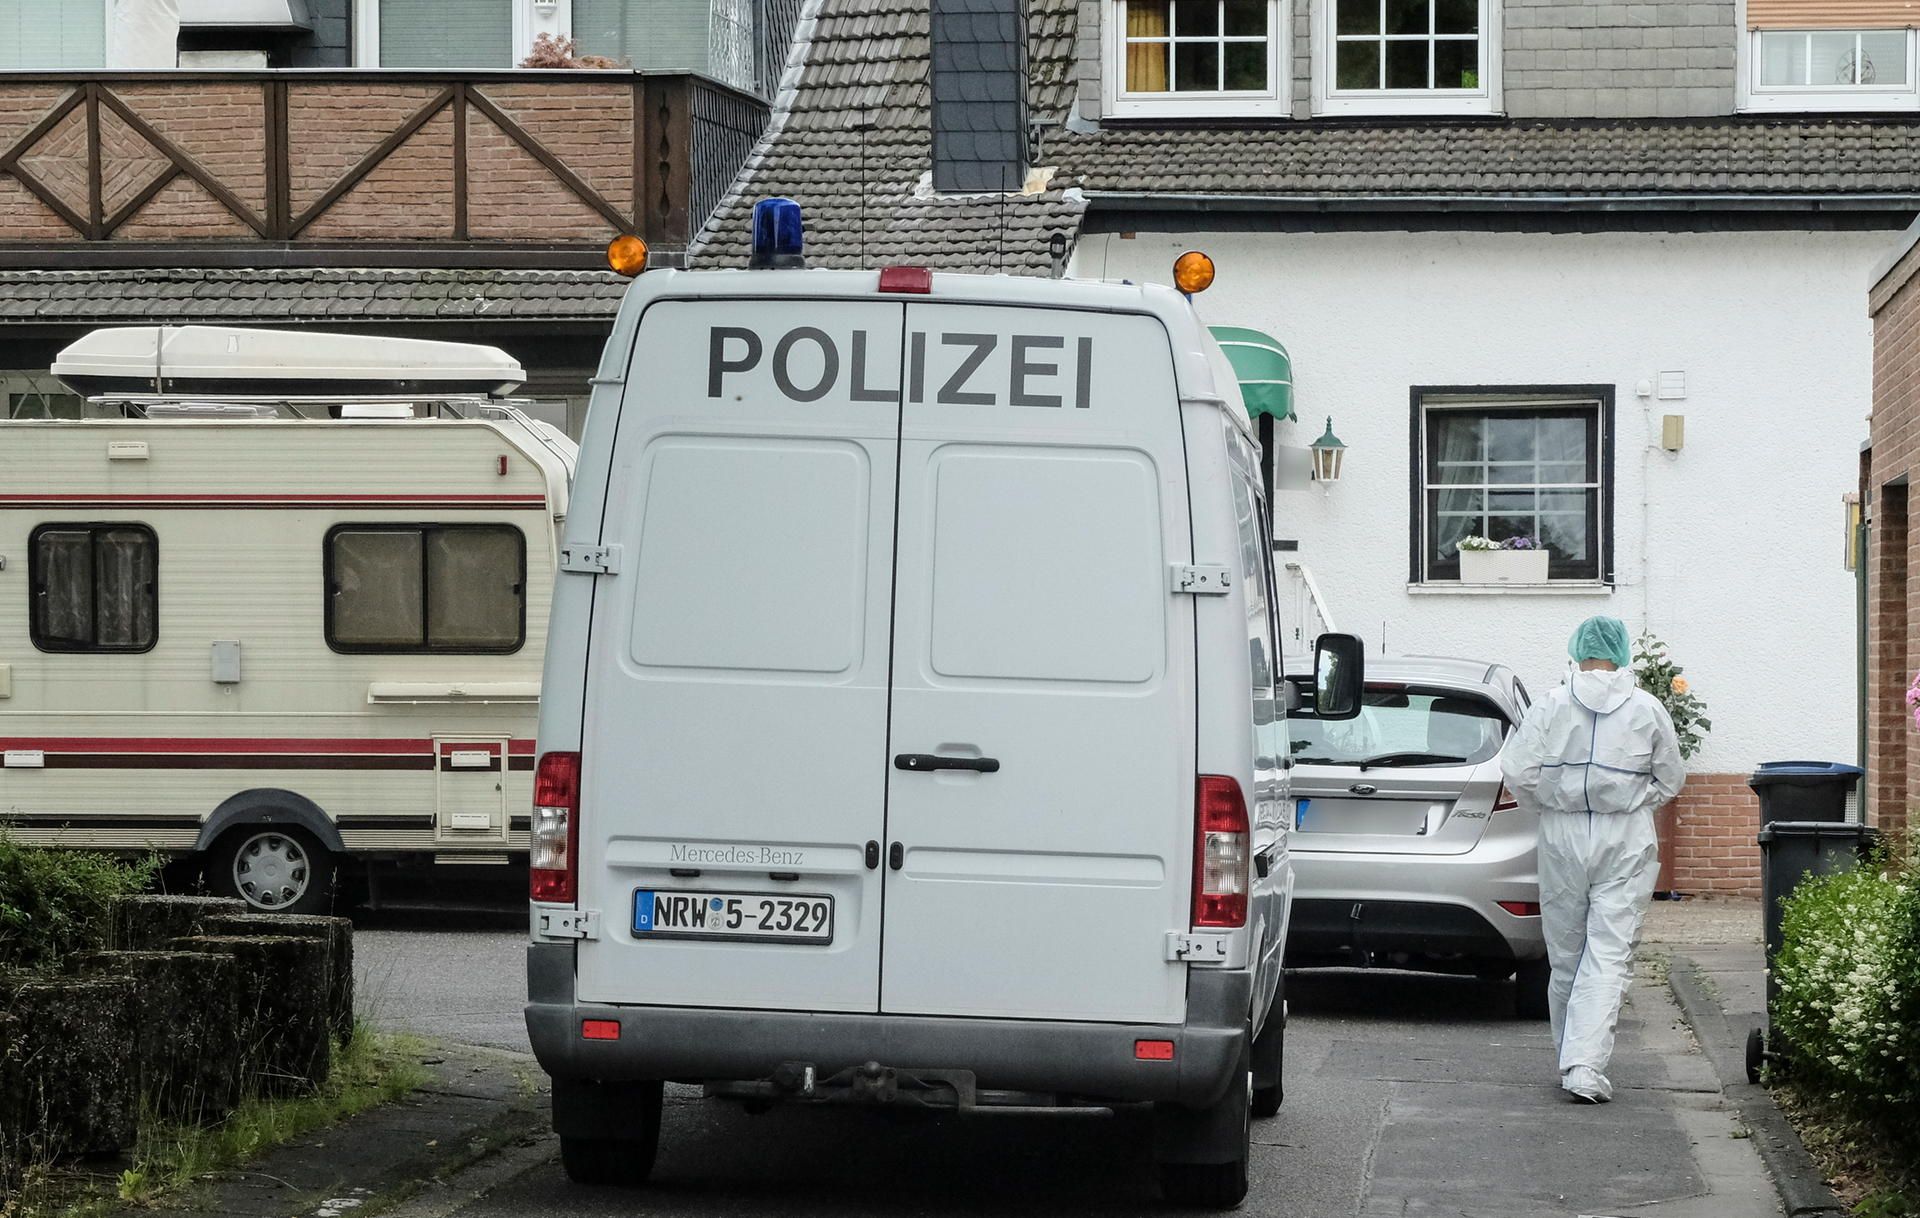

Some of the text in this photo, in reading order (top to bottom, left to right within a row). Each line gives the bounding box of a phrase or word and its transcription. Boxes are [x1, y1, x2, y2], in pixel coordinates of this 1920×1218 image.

[708, 326, 1092, 409] POLIZEI
[670, 844, 804, 865] Mercedes-Benz
[641, 896, 828, 932] D NRW 5-2329
